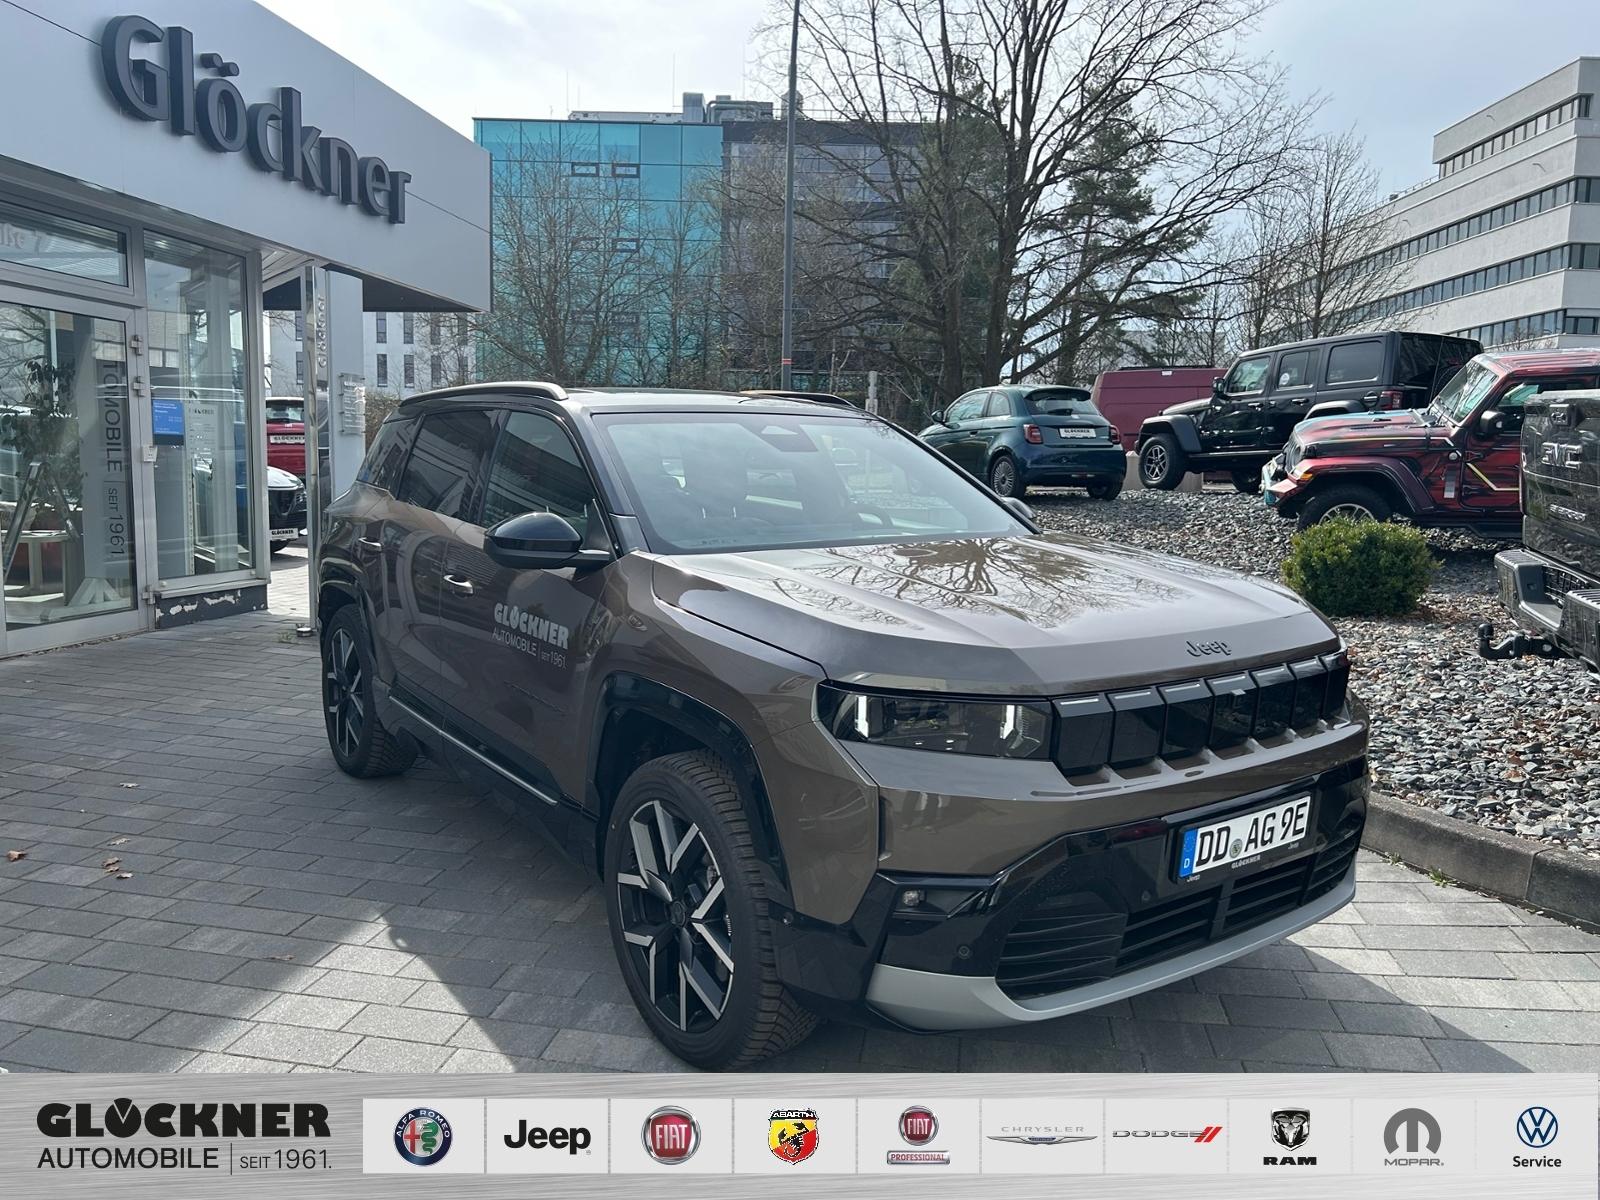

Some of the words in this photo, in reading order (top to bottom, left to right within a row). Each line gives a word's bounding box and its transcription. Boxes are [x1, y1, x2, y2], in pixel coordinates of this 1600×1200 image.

[101, 15, 411, 223] Glöckner
[108, 487, 118, 512] SEIT
[492, 627, 536, 656] AUTOMOBILE
[1185, 640, 1232, 657] Jeep
[1196, 826, 1231, 867] DD
[1244, 812, 1276, 852] AG
[1280, 802, 1308, 840] 9E
[1183, 858, 1190, 868] D
